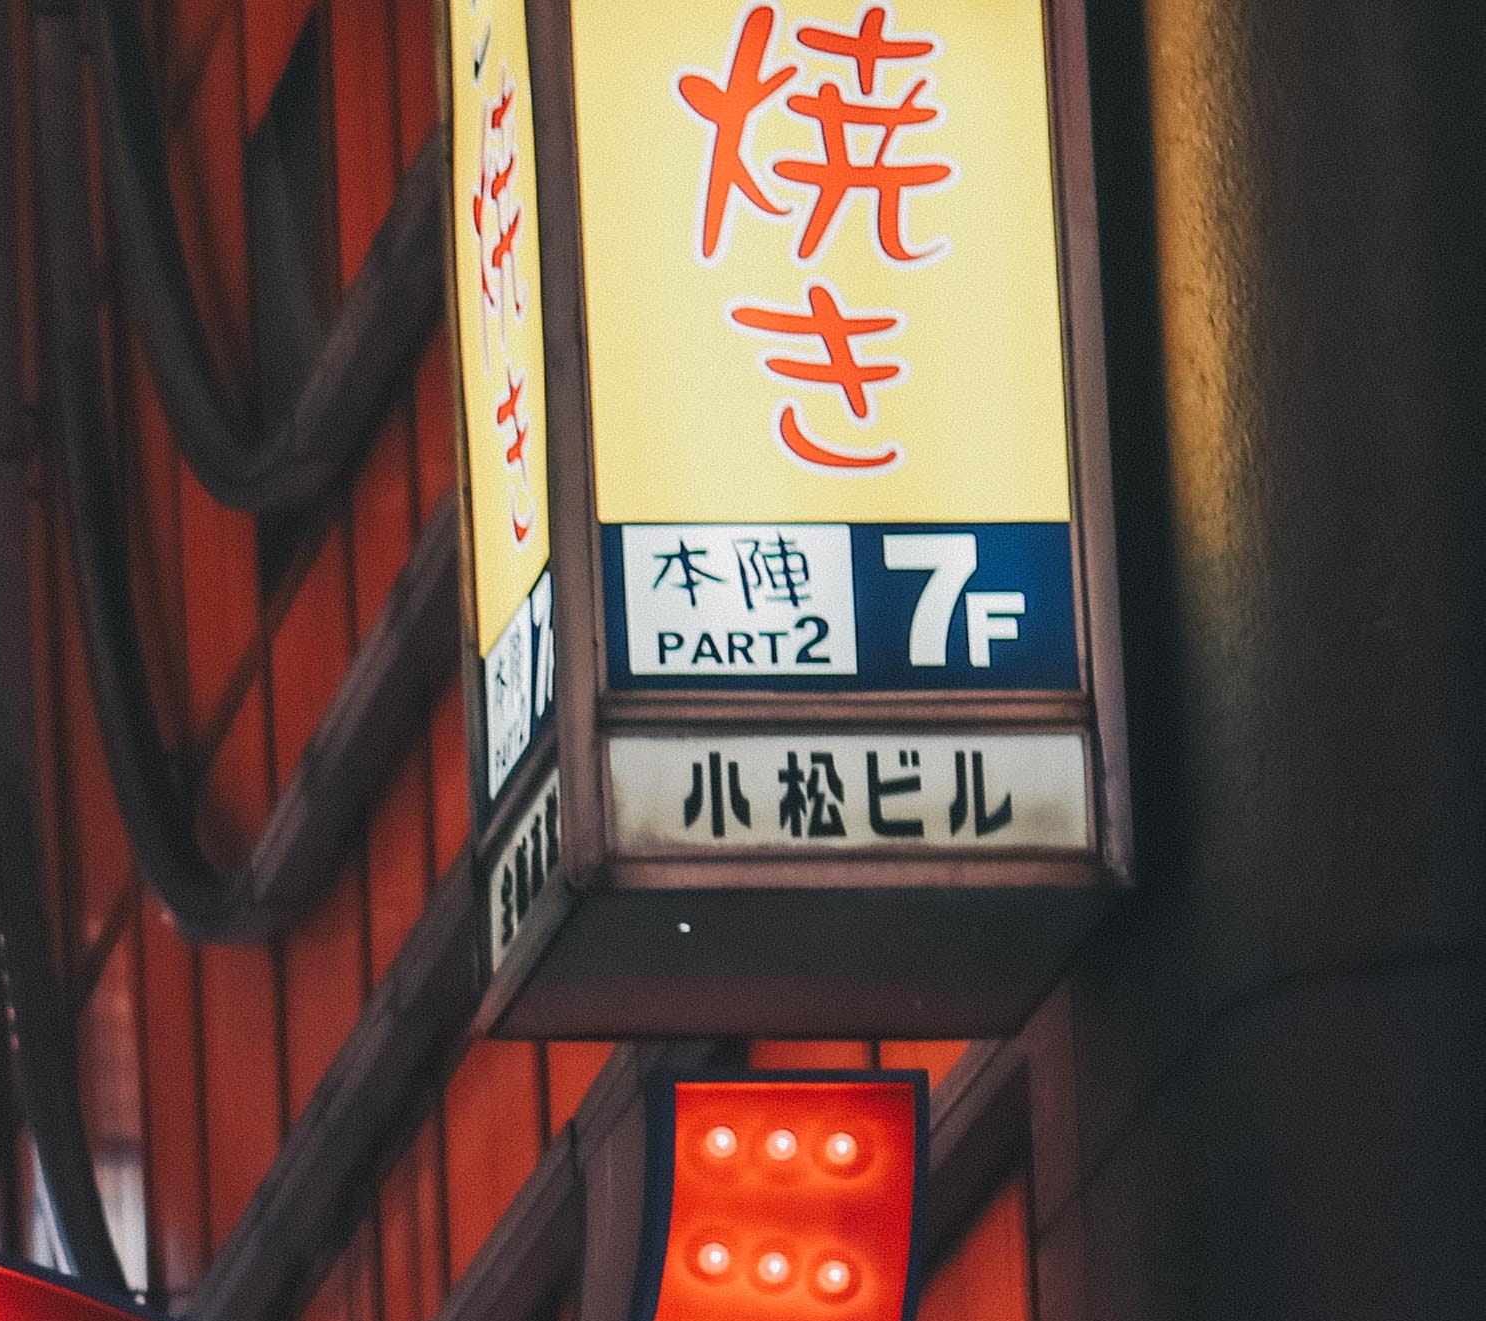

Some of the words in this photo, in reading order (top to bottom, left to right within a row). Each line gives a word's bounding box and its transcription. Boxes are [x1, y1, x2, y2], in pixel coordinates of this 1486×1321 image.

[678, 6, 951, 468] 焼き
[652, 534, 812, 612] 本陣
[881, 532, 1027, 669] 7F
[655, 616, 833, 667] PART2
[684, 750, 1014, 840] 小松ビル
